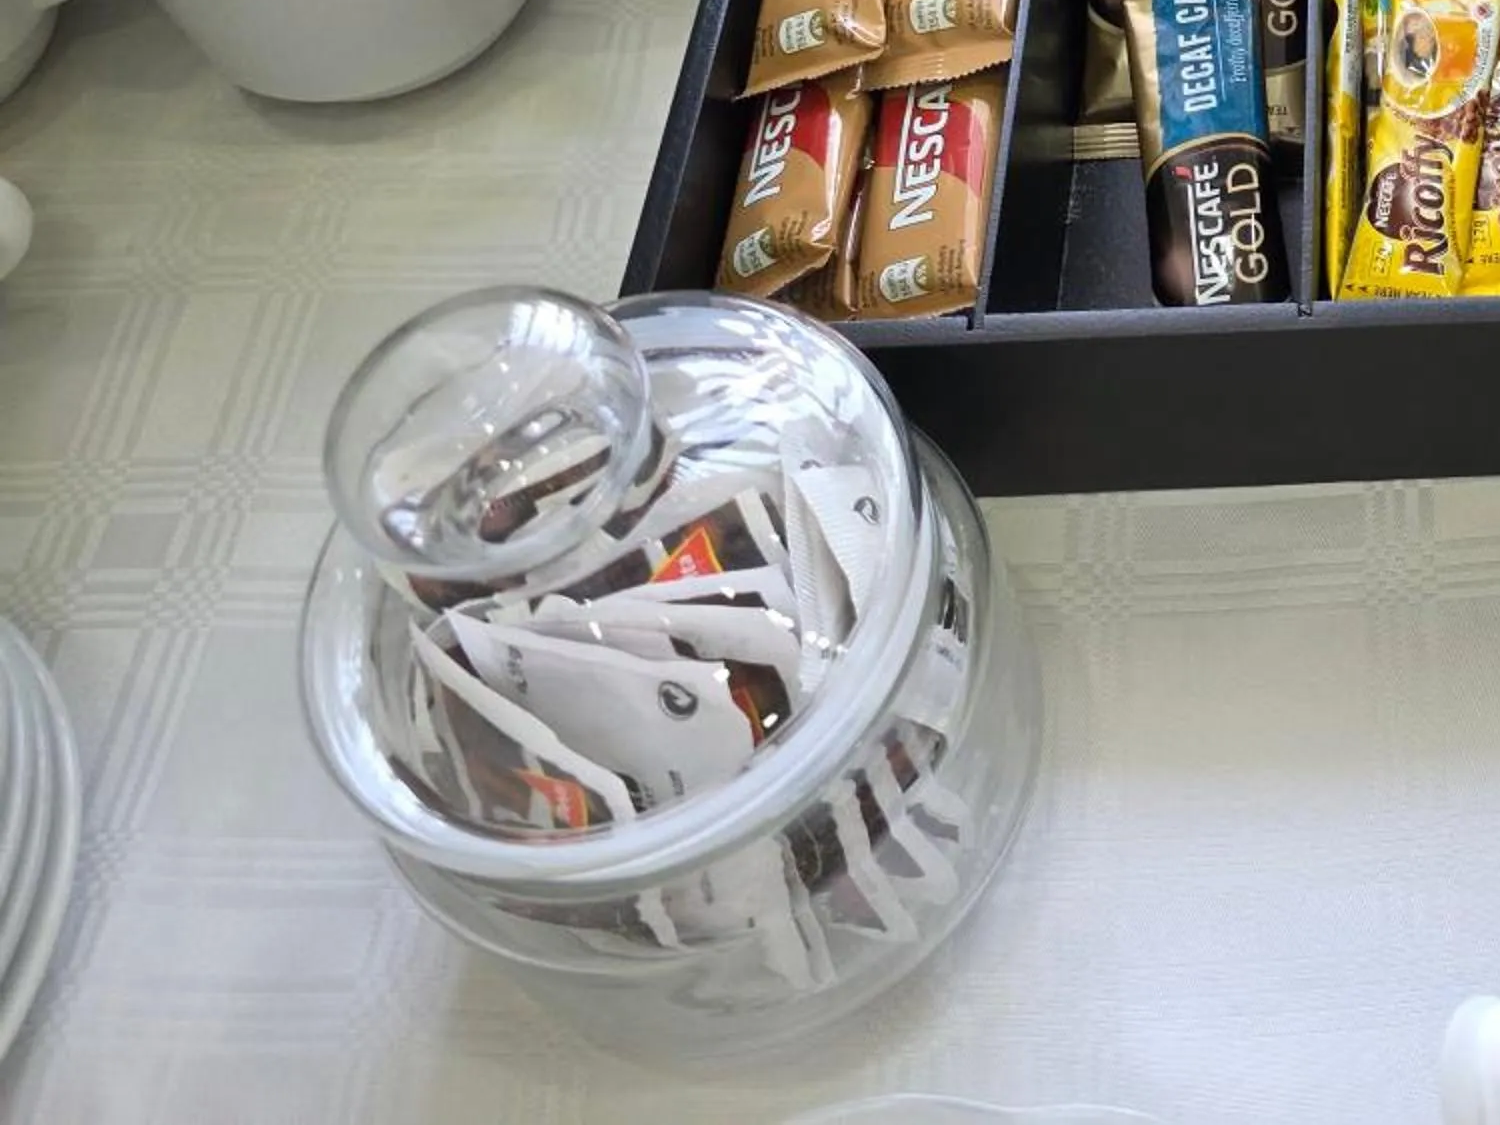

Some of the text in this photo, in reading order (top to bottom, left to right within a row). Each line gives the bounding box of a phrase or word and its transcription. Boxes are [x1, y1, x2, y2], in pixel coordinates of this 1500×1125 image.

[1177, 32, 1218, 113] DECAF
[1266, 105, 1288, 117] TEA
[743, 88, 800, 209] NESC
[888, 83, 953, 231] NESCA
[1400, 134, 1455, 276] Ricoffy
[1226, 163, 1269, 285] GOLD
